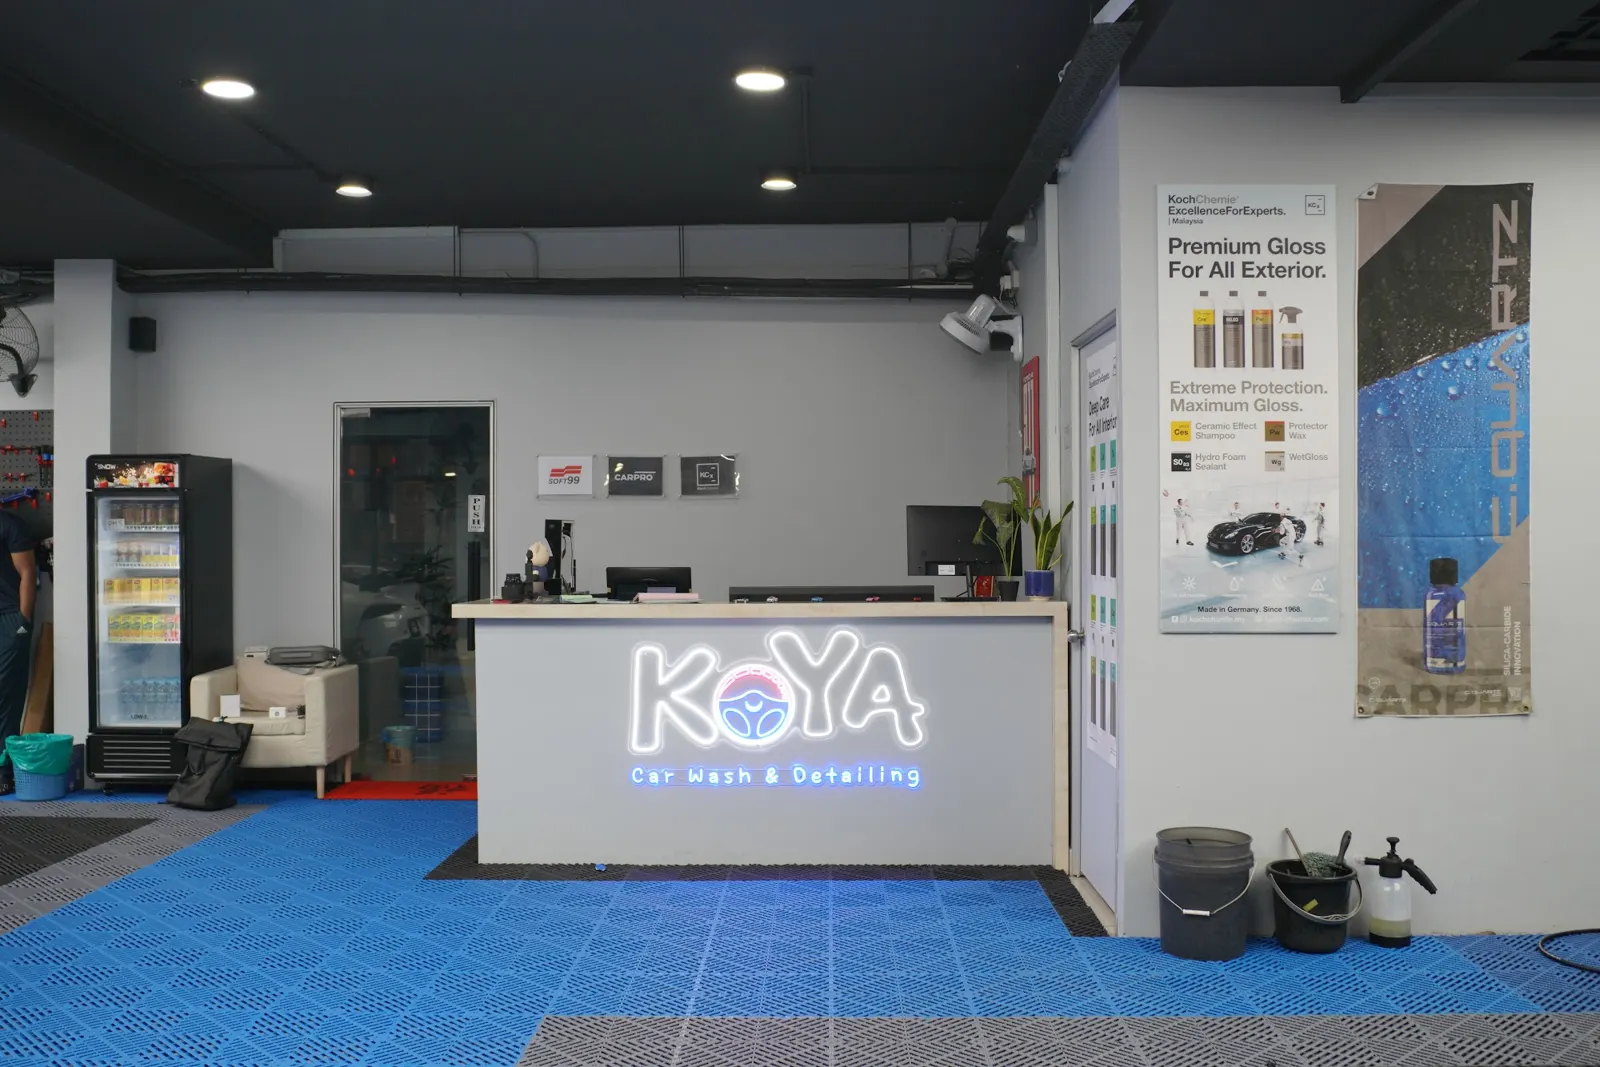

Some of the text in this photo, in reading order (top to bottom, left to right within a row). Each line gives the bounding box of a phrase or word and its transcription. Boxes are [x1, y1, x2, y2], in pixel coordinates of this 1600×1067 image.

[1168, 206, 1286, 217] ExcellenceForExperts.
[1168, 237, 1326, 254] Premium Gloss
[1169, 261, 1326, 278] For All Exterior.
[1170, 381, 1328, 394] Extreme Protection.
[1089, 396, 1109, 417] Deep Care
[1170, 398, 1303, 412] Maximum Gloss.
[1196, 422, 1230, 430] Ceramic
[1233, 422, 1257, 430] Effect
[1289, 422, 1328, 430] Protector
[1196, 432, 1235, 440] Shampoo
[1196, 453, 1220, 462] Hydro
[1289, 453, 1328, 461] WetGloss
[548, 476, 580, 484] SOFT99
[472, 498, 481, 525] PUSH
[1228, 606, 1261, 614] Germany.
[1504, 606, 1512, 676] SILICA-CARBIDE
[1514, 621, 1522, 676] INNOVATION
[631, 630, 925, 752] KOYA
[632, 767, 920, 788] Car Wash & Detailing
